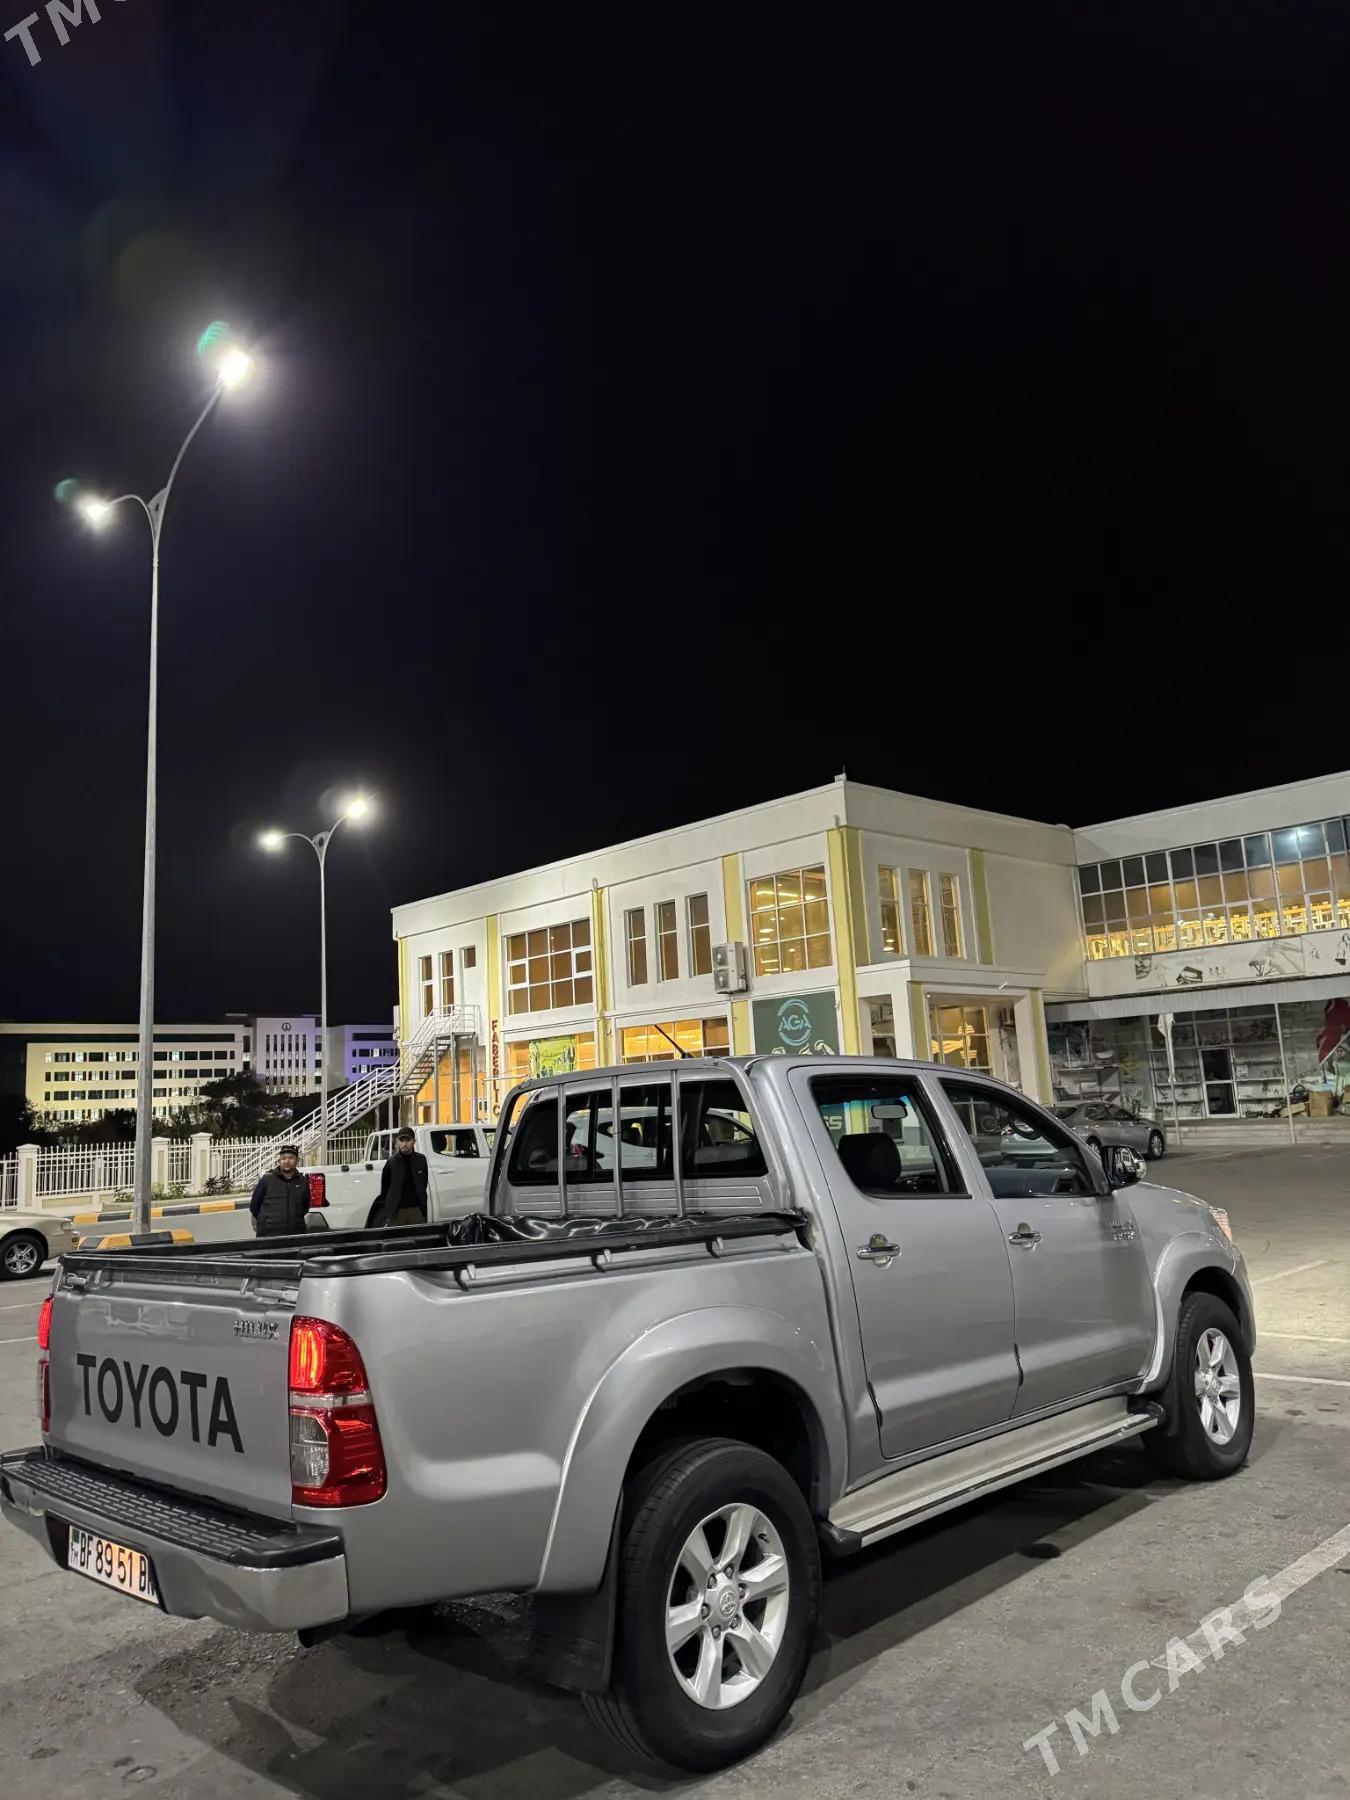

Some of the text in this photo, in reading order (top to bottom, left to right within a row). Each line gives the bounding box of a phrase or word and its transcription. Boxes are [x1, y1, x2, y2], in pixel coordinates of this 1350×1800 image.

[778, 1013, 812, 1032] AGA
[76, 1352, 246, 1454] TOYOTA
[79, 1529, 94, 1569] BF
